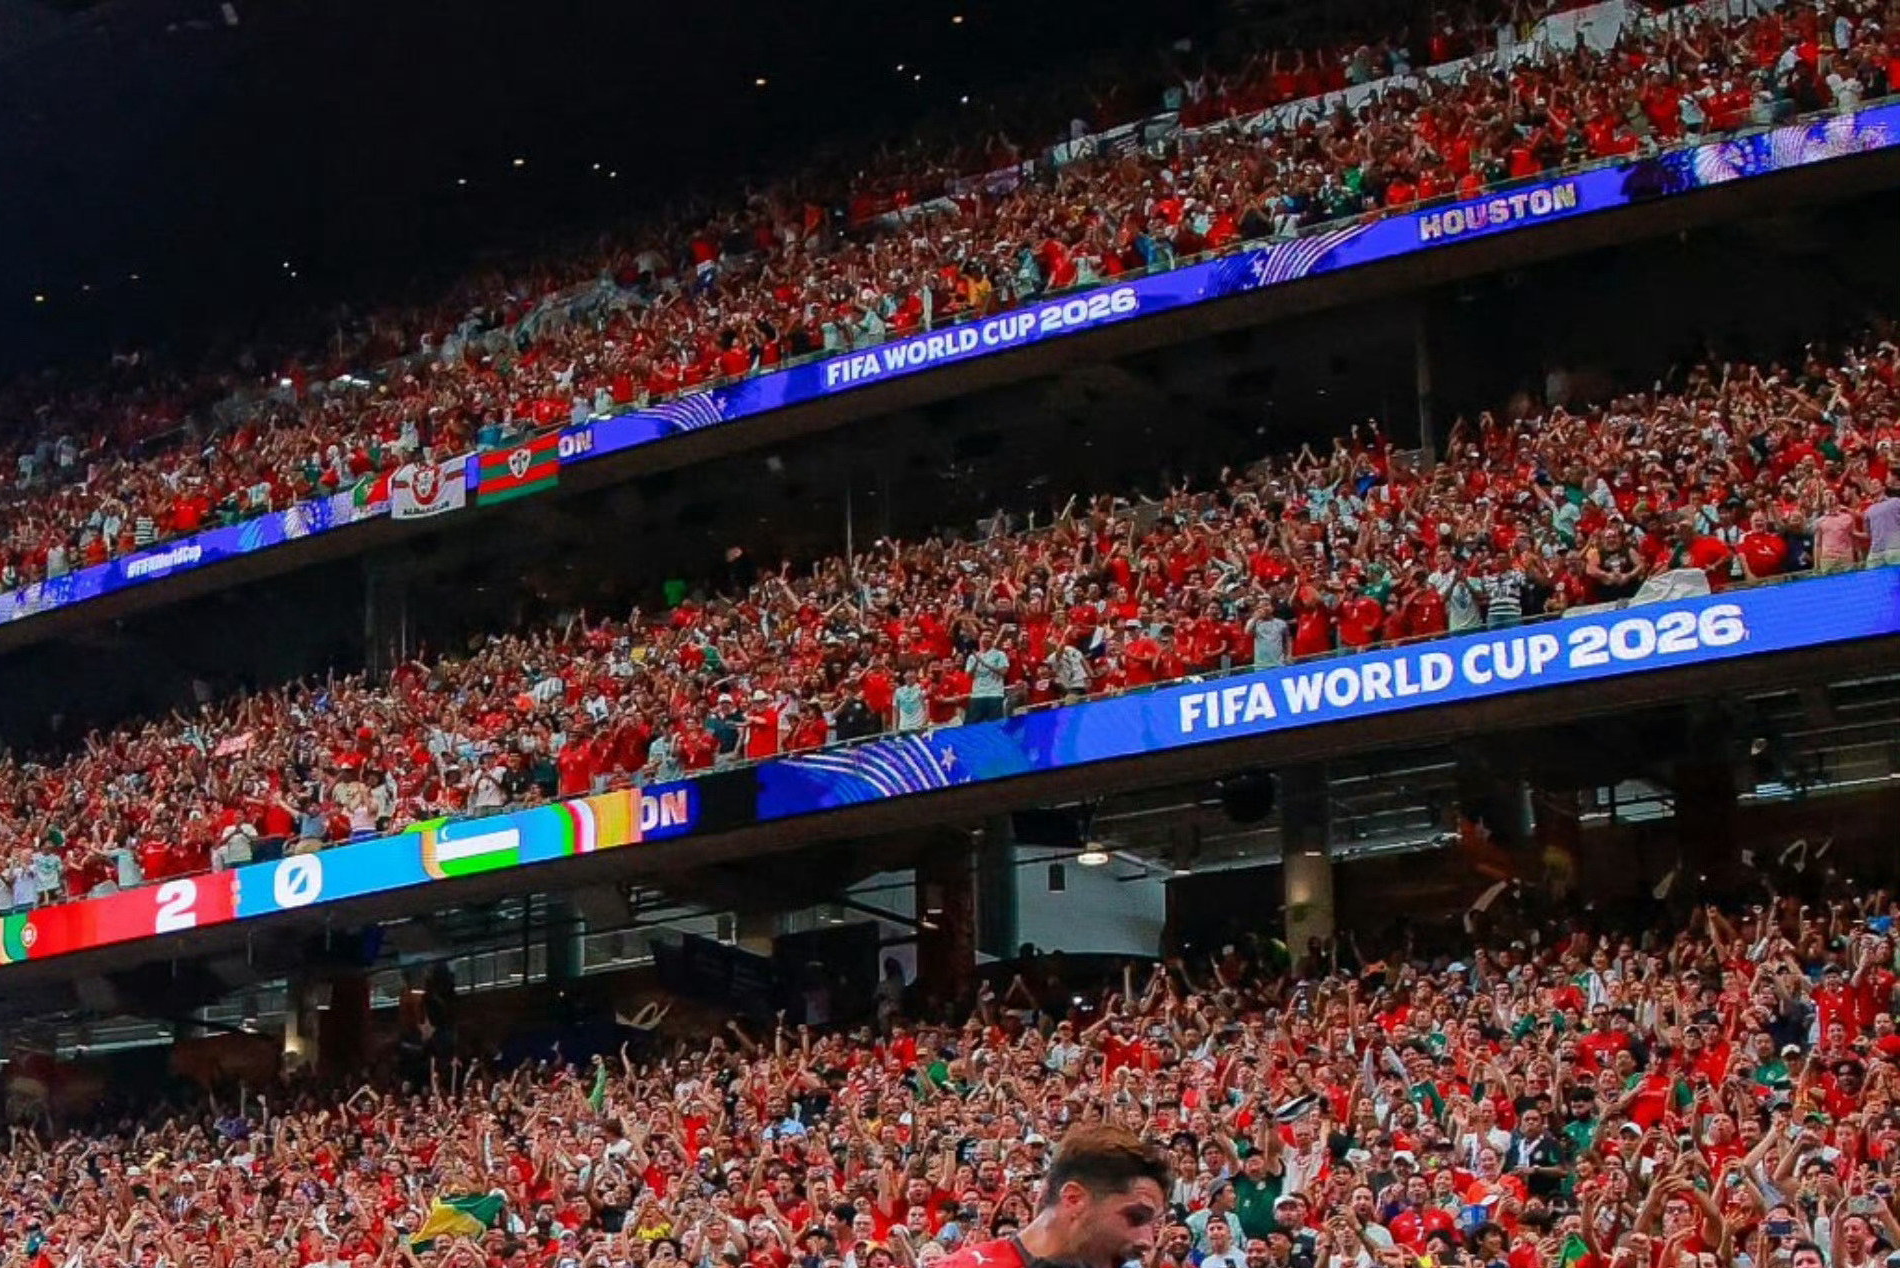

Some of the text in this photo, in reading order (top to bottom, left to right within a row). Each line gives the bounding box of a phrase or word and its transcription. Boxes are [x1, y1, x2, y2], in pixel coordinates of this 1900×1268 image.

[1420, 182, 1576, 241] HOUSTON
[826, 287, 1137, 387] FIFA WORLD CUP 2026
[1179, 603, 1745, 734] FIFA WORLD CUP 2026
[155, 879, 197, 934] 2
